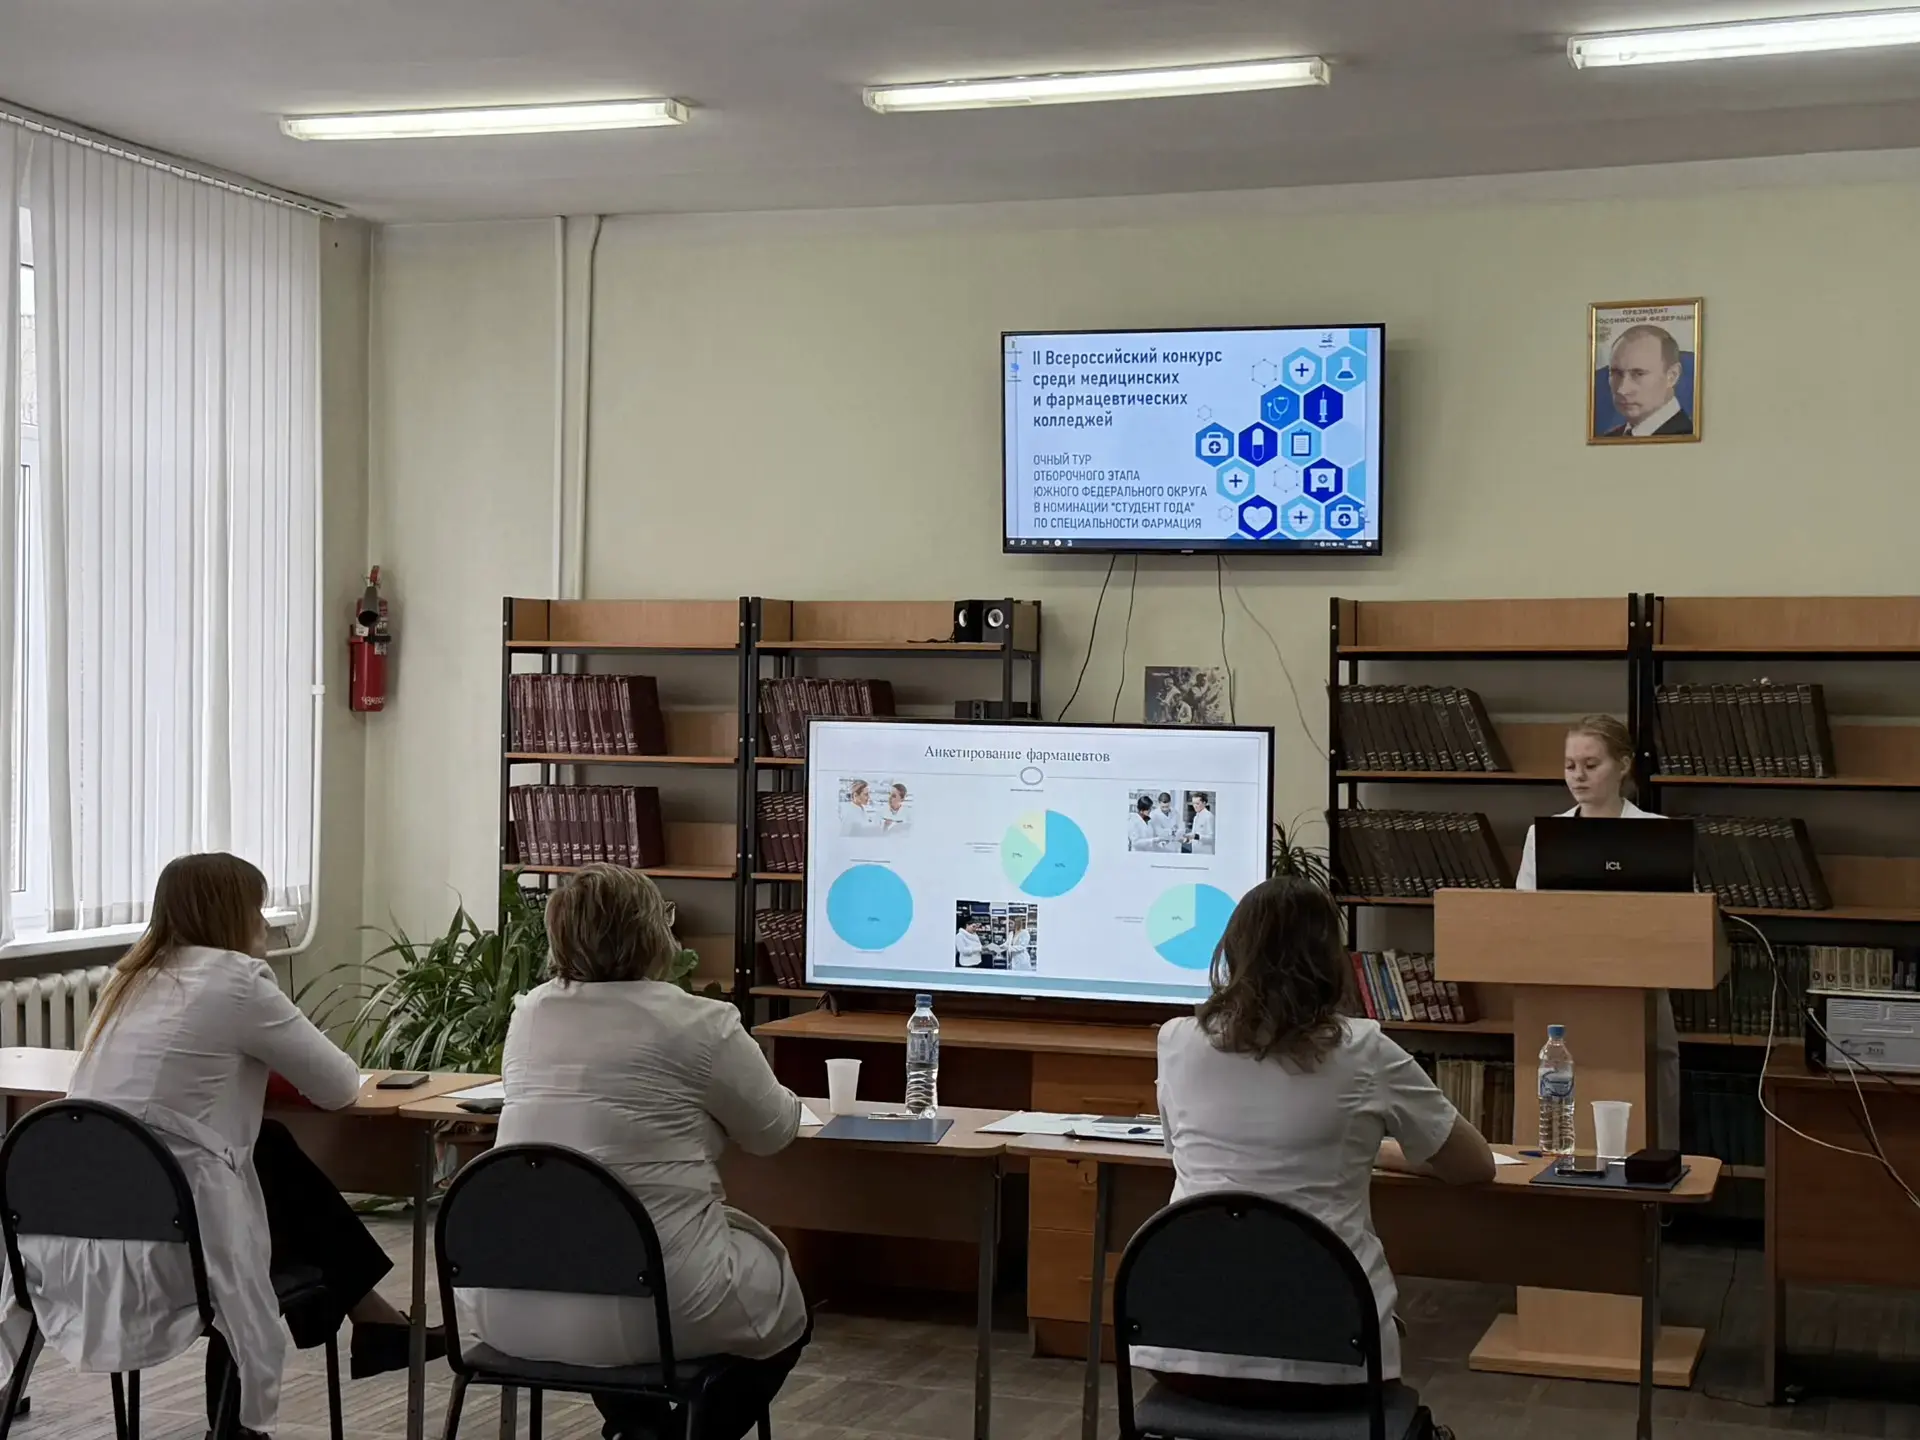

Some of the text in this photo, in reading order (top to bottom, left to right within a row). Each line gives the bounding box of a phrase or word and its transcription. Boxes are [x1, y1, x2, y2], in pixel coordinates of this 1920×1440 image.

[1046, 347, 1157, 368] Всероссийский
[1162, 351, 1223, 366] конкурс
[1033, 373, 1180, 389] среди медицинских
[1033, 393, 1188, 410] и фармацевтических
[1033, 410, 1113, 429] колледжей
[1033, 452, 1092, 465] ОЧНЫЙ ТУР
[1033, 470, 1140, 481] ОТБОРОЧНОГО ЭТАПА
[1034, 486, 1208, 498] ЮЖНОГО ФЕДЕРАЛЬНОГО ОКРУГА
[1034, 502, 1041, 513] В
[1043, 502, 1109, 514] НОМИНАЦИИ
[1034, 517, 1202, 530] ПО СПЕЦИАЛЬНОСТИ ФАРМАЦИЯ
[925, 745, 1110, 763] Анкетирование фармацевтов
